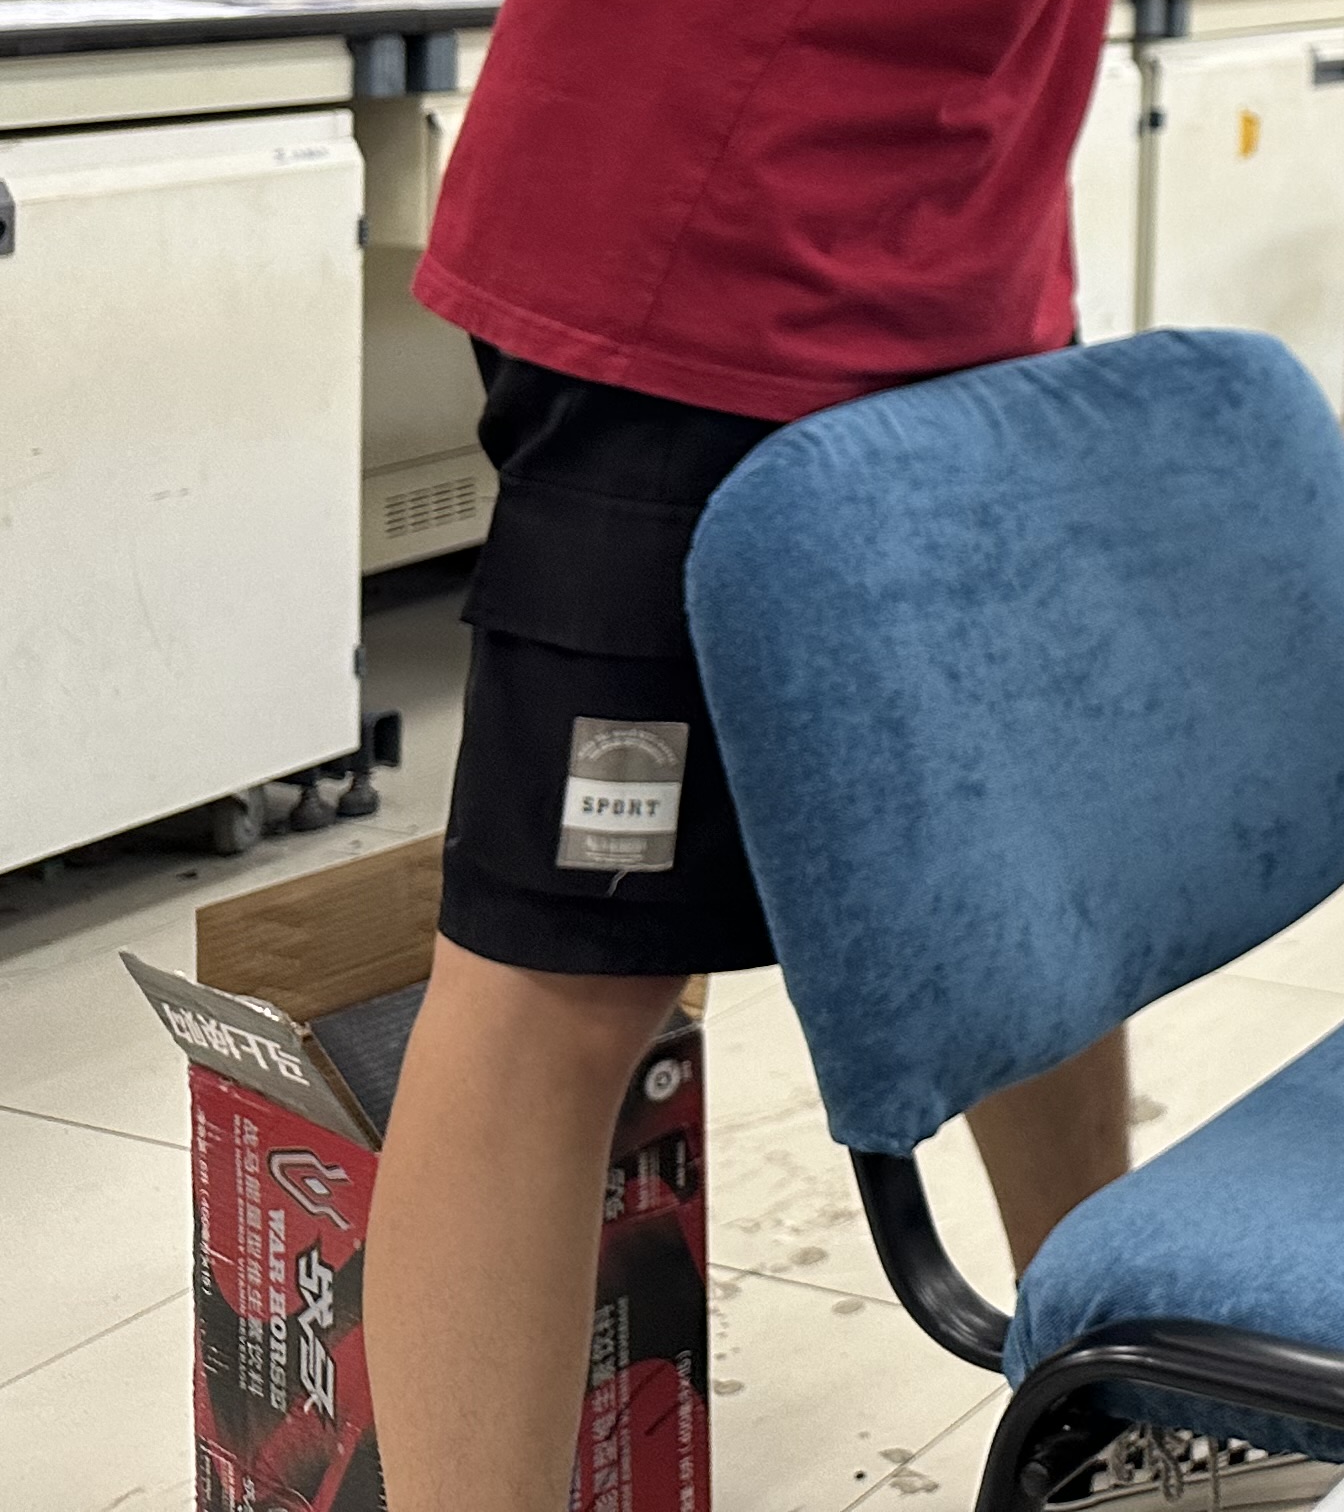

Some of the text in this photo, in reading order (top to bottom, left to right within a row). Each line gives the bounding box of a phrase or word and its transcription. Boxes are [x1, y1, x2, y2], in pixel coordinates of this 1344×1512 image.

[582, 796, 660, 817] SPORT
[161, 1002, 311, 1087] 马上换购
[268, 1209, 287, 1410] WAR HORSE
